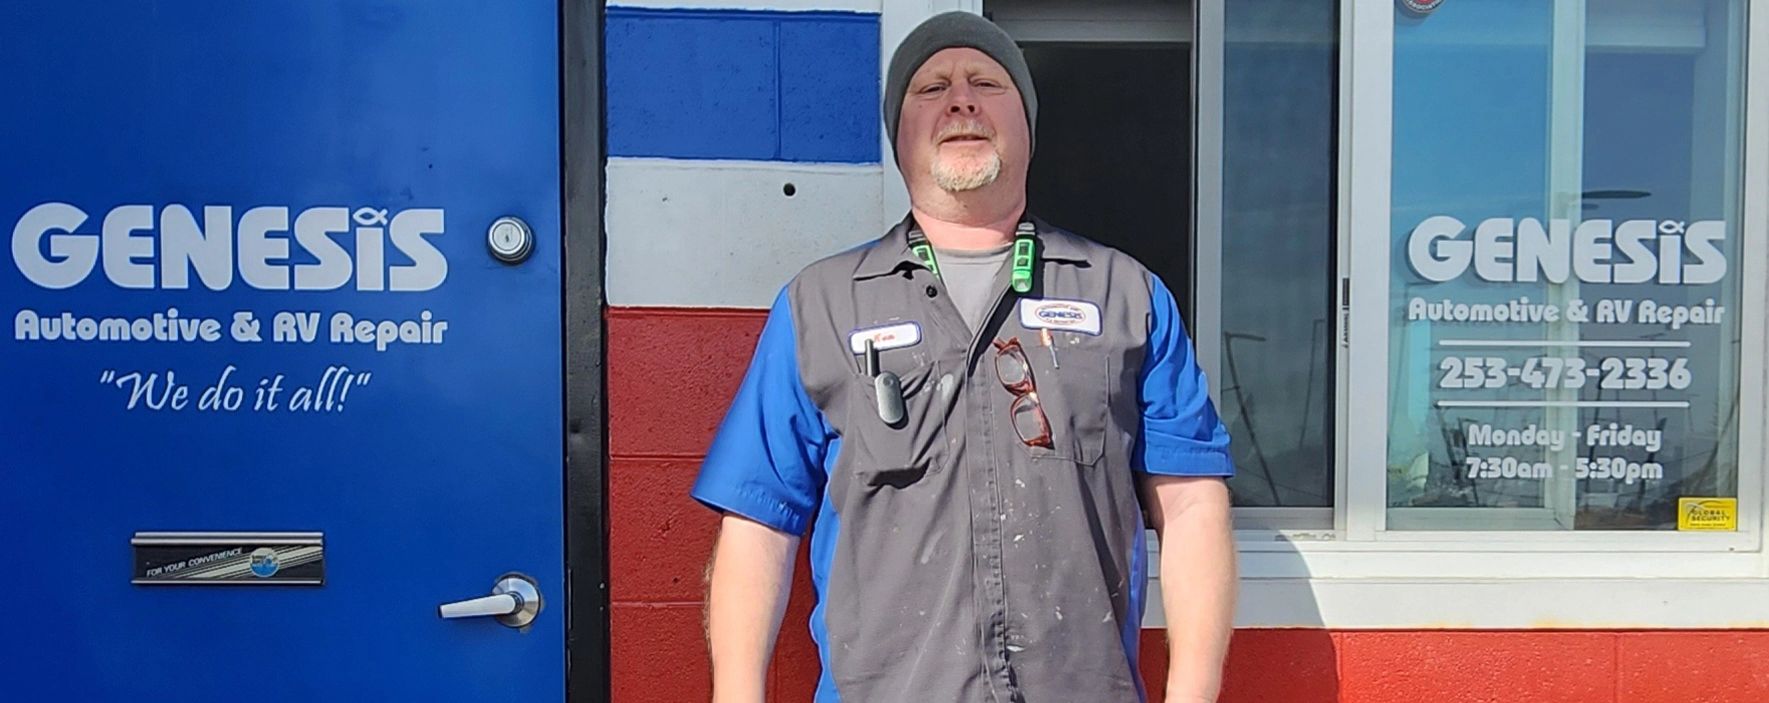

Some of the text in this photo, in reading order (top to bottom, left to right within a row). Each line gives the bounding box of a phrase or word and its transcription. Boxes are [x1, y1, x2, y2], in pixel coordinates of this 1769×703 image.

[11, 202, 449, 292] GENESIS
[1408, 215, 1727, 284] GENESIS
[14, 308, 449, 351] Automotive & RV Repair
[1408, 297, 1726, 329] Automotive & RV Repair
[198, 365, 245, 412] do
[254, 377, 279, 411] it
[1439, 357, 1692, 390] 253-473-2336
[1468, 424, 1566, 451] Monday
[1587, 423, 1662, 452] Friday
[1466, 457, 1553, 479] 7:30am
[1575, 457, 1663, 484] 5:30pm
[146, 569, 163, 578] FOR
[164, 561, 186, 573] YOUR
[188, 547, 243, 567] CONVENIENCE
